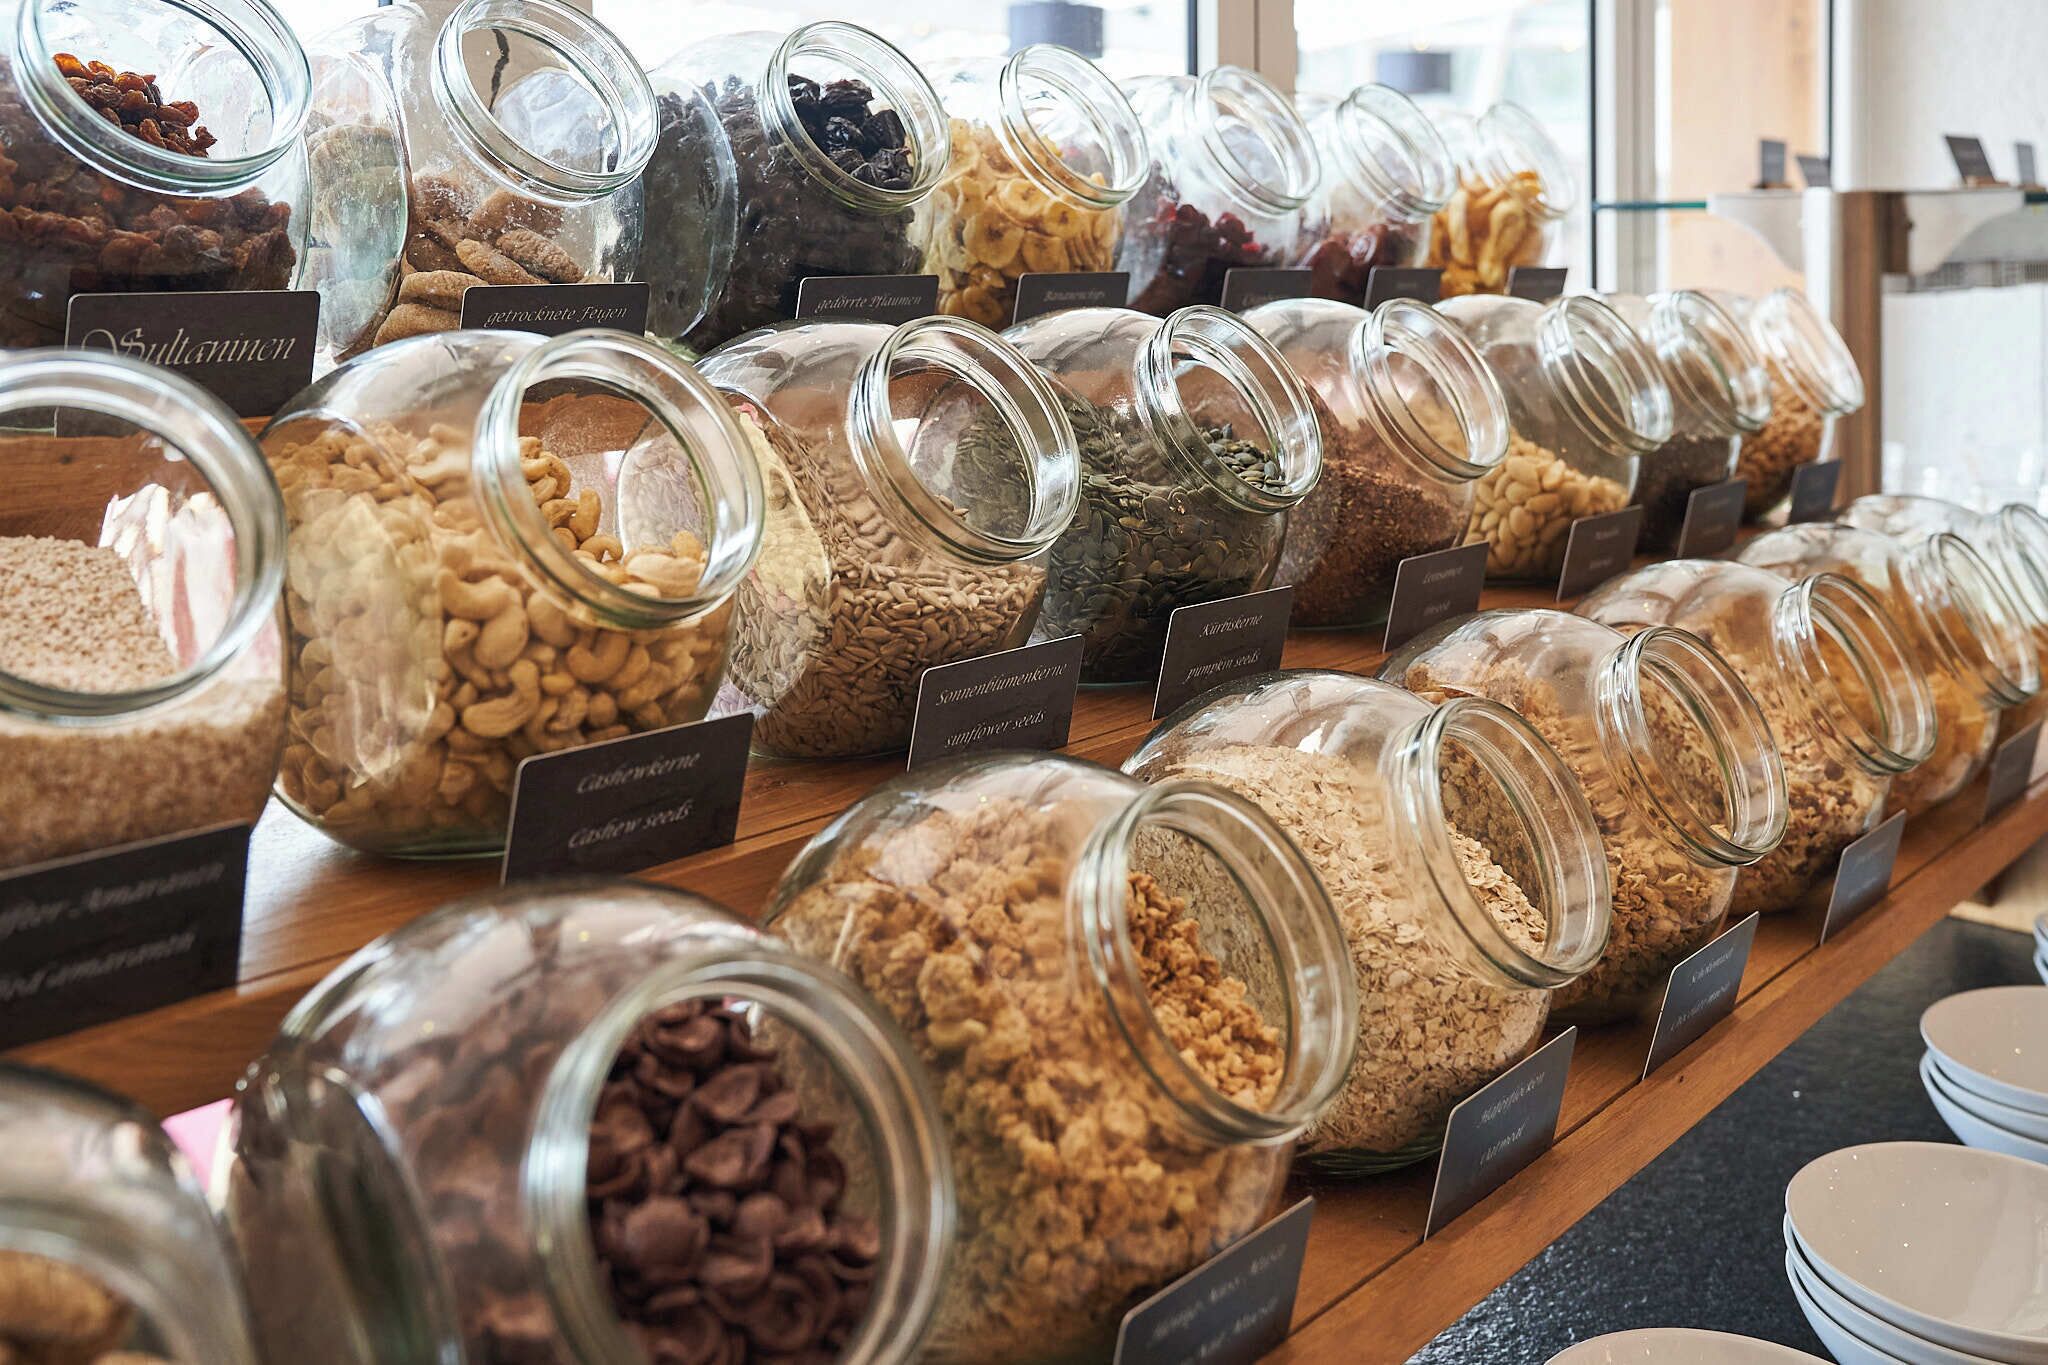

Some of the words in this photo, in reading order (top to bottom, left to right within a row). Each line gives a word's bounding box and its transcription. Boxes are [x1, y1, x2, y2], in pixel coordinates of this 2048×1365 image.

[483, 305, 576, 328] getrocknete
[81, 327, 296, 366] Sultaninen
[1199, 614, 1263, 638] Kürbiskerne
[935, 663, 1067, 706] Sonnenblumenkerne
[1182, 657, 1233, 685] pumpkin
[1234, 648, 1261, 667] seeds
[944, 717, 1013, 748] sunflower
[1013, 708, 1047, 730] seeds
[576, 752, 701, 794] Cashewkerne
[567, 817, 642, 849] Cashew
[643, 799, 694, 829] seeds
